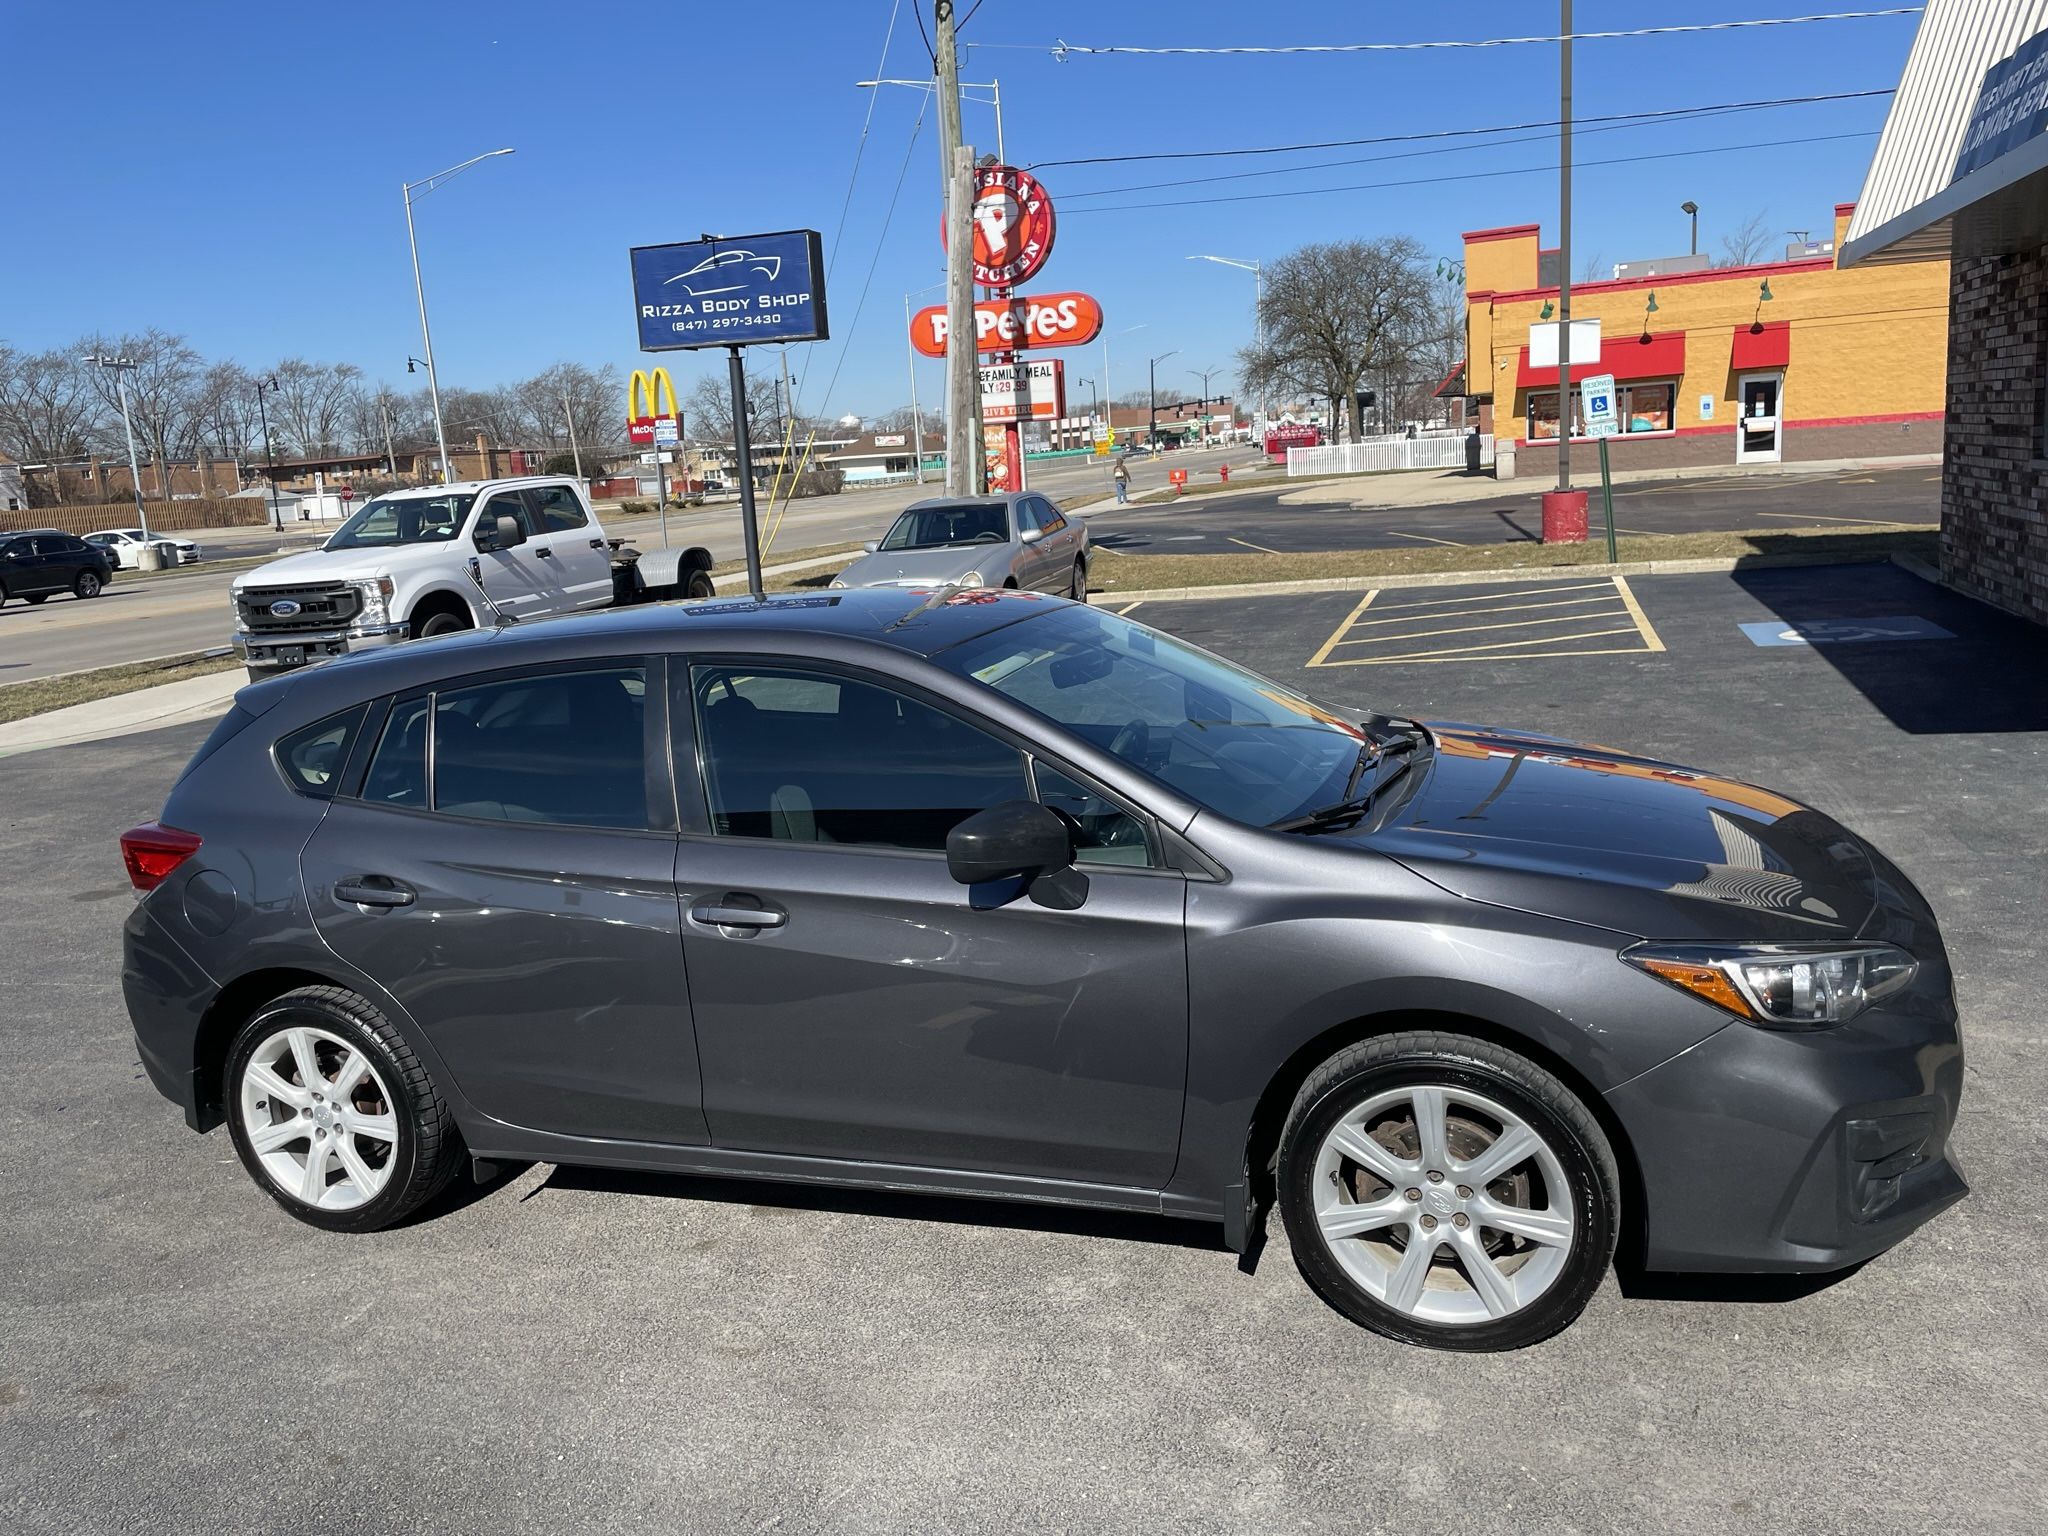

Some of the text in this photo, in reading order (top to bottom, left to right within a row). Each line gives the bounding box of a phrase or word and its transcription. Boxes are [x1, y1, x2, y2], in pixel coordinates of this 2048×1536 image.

[974, 239, 1041, 282] TCHEN
[642, 293, 810, 318] RIZZA BODY SHOP
[672, 314, 781, 332] (847) 297-3430
[1025, 365, 1052, 378] MEAL
[980, 382, 994, 394] LY
[1584, 380, 1612, 388] RESERVED
[1586, 387, 1611, 396] PARKING
[983, 404, 1032, 417] RIVE THRU
[1604, 424, 1617, 434] FINE
